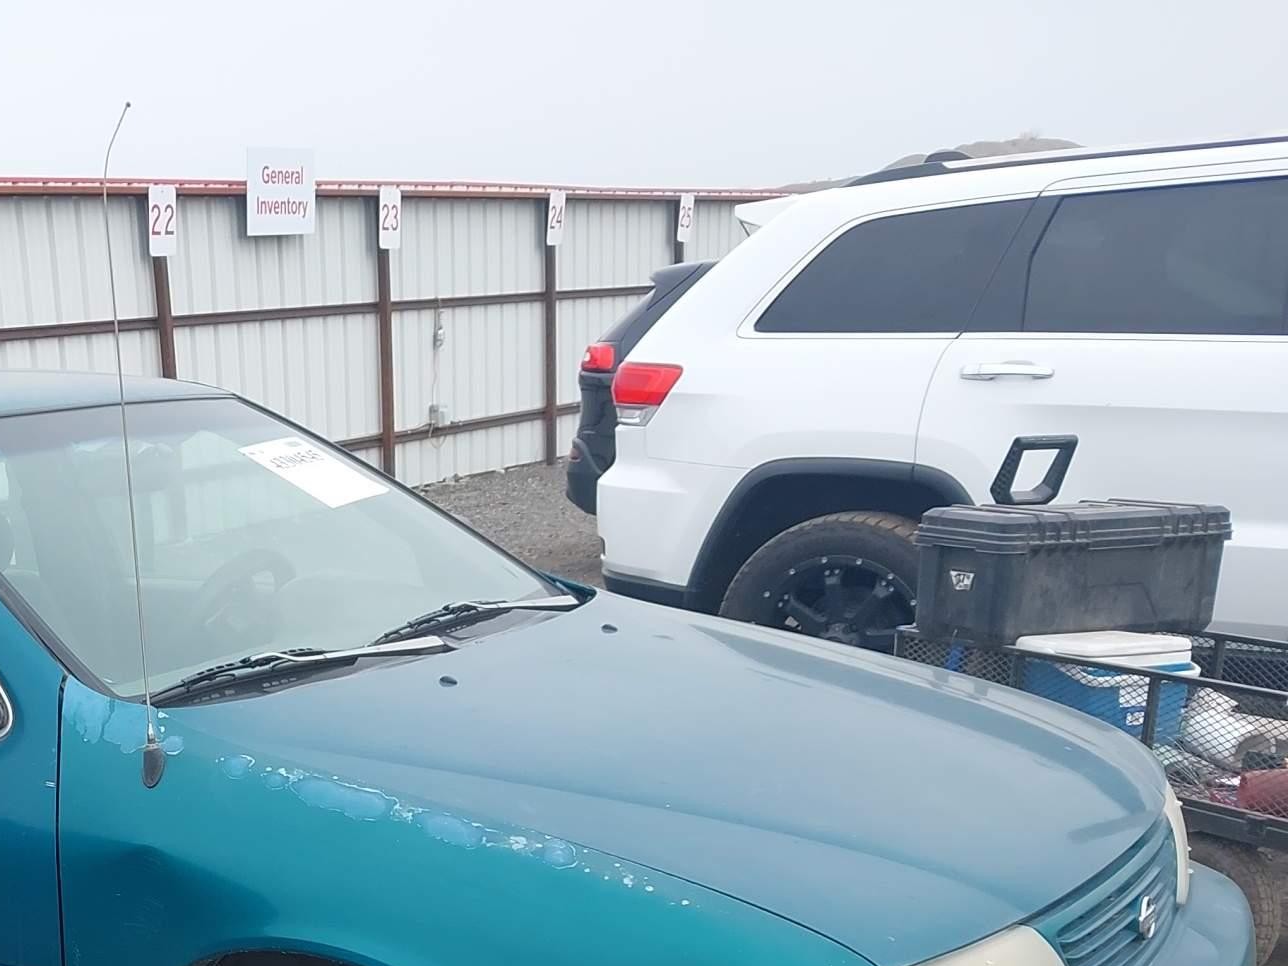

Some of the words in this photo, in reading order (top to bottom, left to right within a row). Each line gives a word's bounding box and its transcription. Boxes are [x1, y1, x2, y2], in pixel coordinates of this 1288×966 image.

[261, 165, 304, 185] General
[256, 195, 309, 219] Inventory
[382, 203, 399, 231] 23
[549, 204, 563, 230] 24
[679, 205, 692, 229] 25
[151, 204, 175, 236] 22
